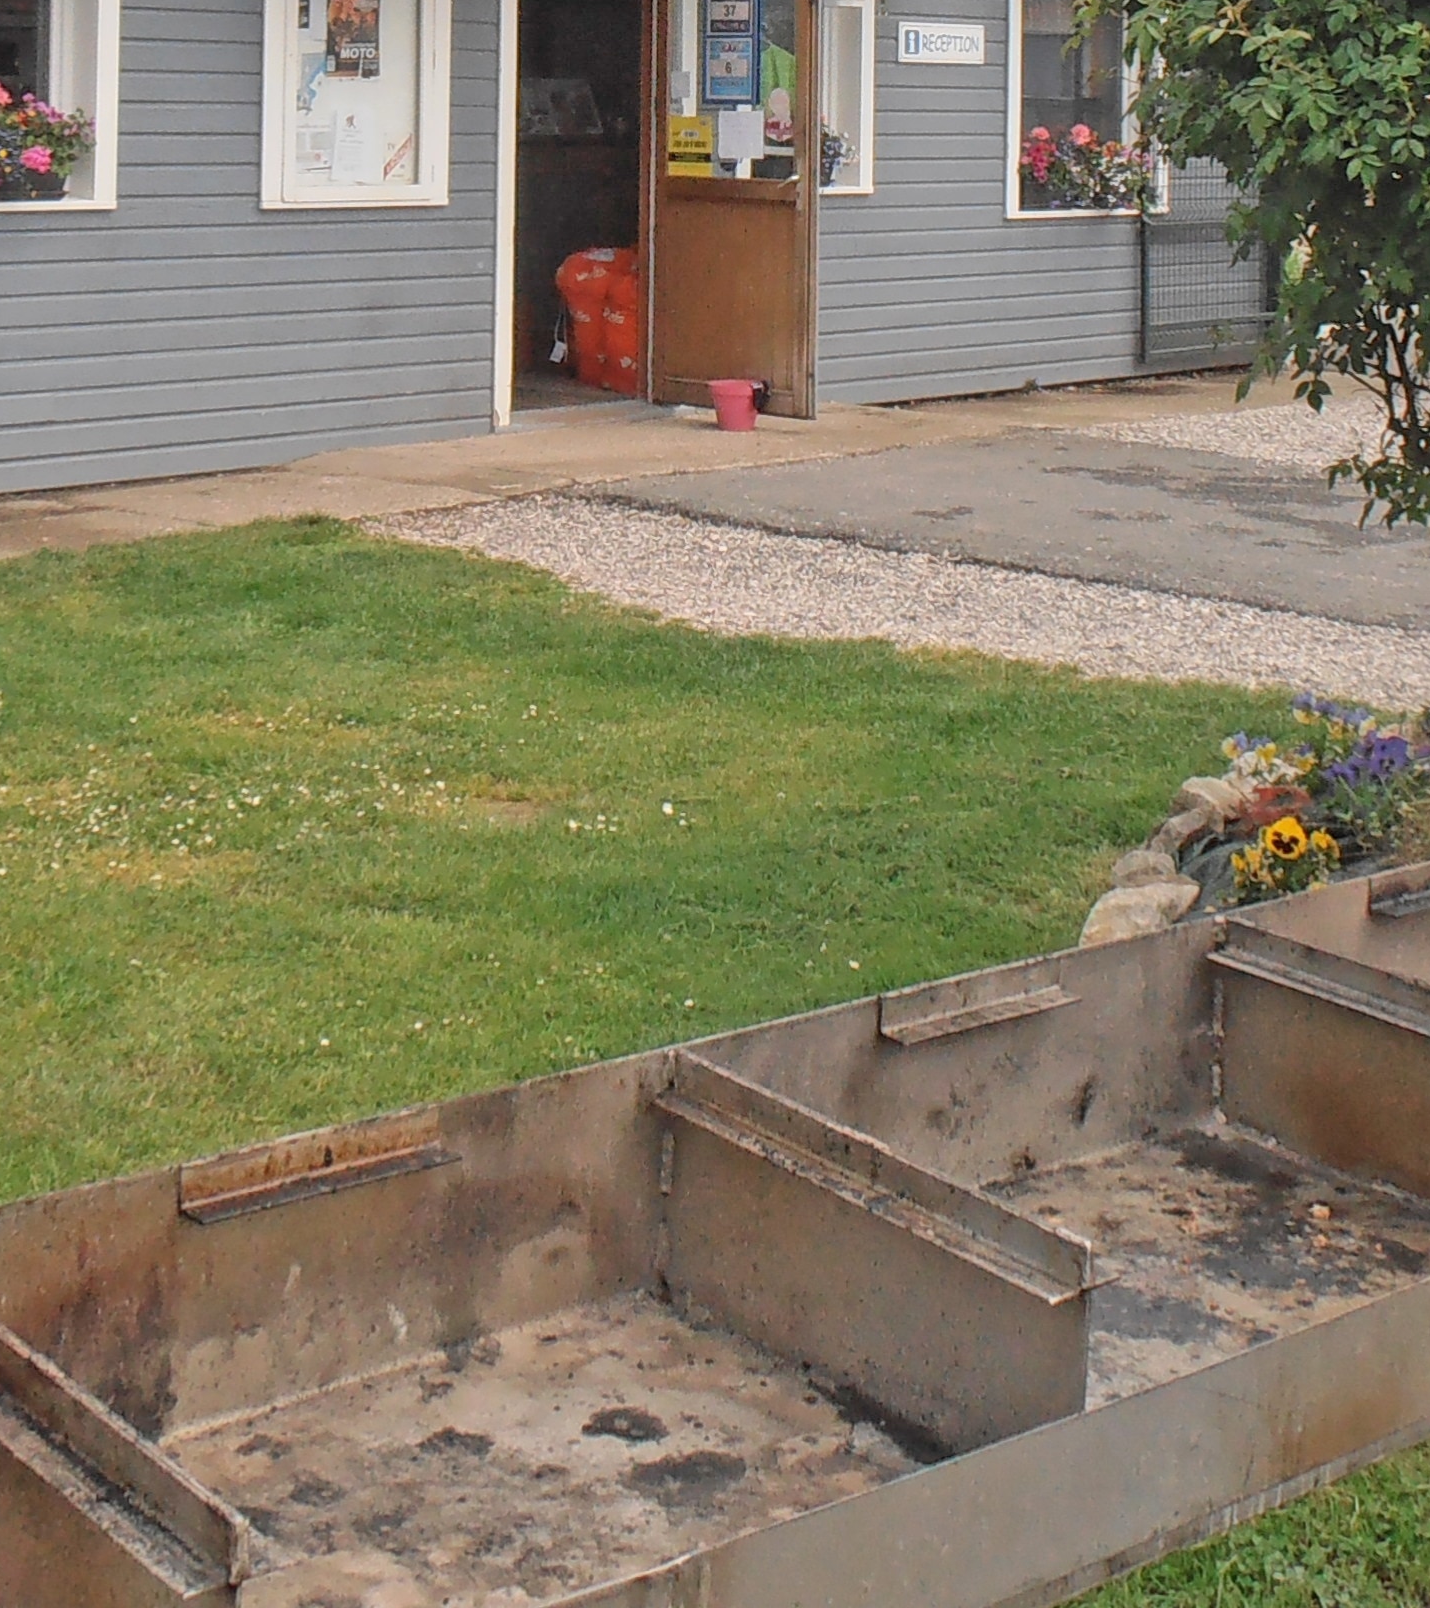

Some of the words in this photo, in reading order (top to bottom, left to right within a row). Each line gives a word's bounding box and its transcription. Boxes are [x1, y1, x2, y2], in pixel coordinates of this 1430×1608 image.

[723, 4, 737, 18] 37
[921, 33, 980, 53] RECEPTION
[340, 47, 376, 59] MOTO
